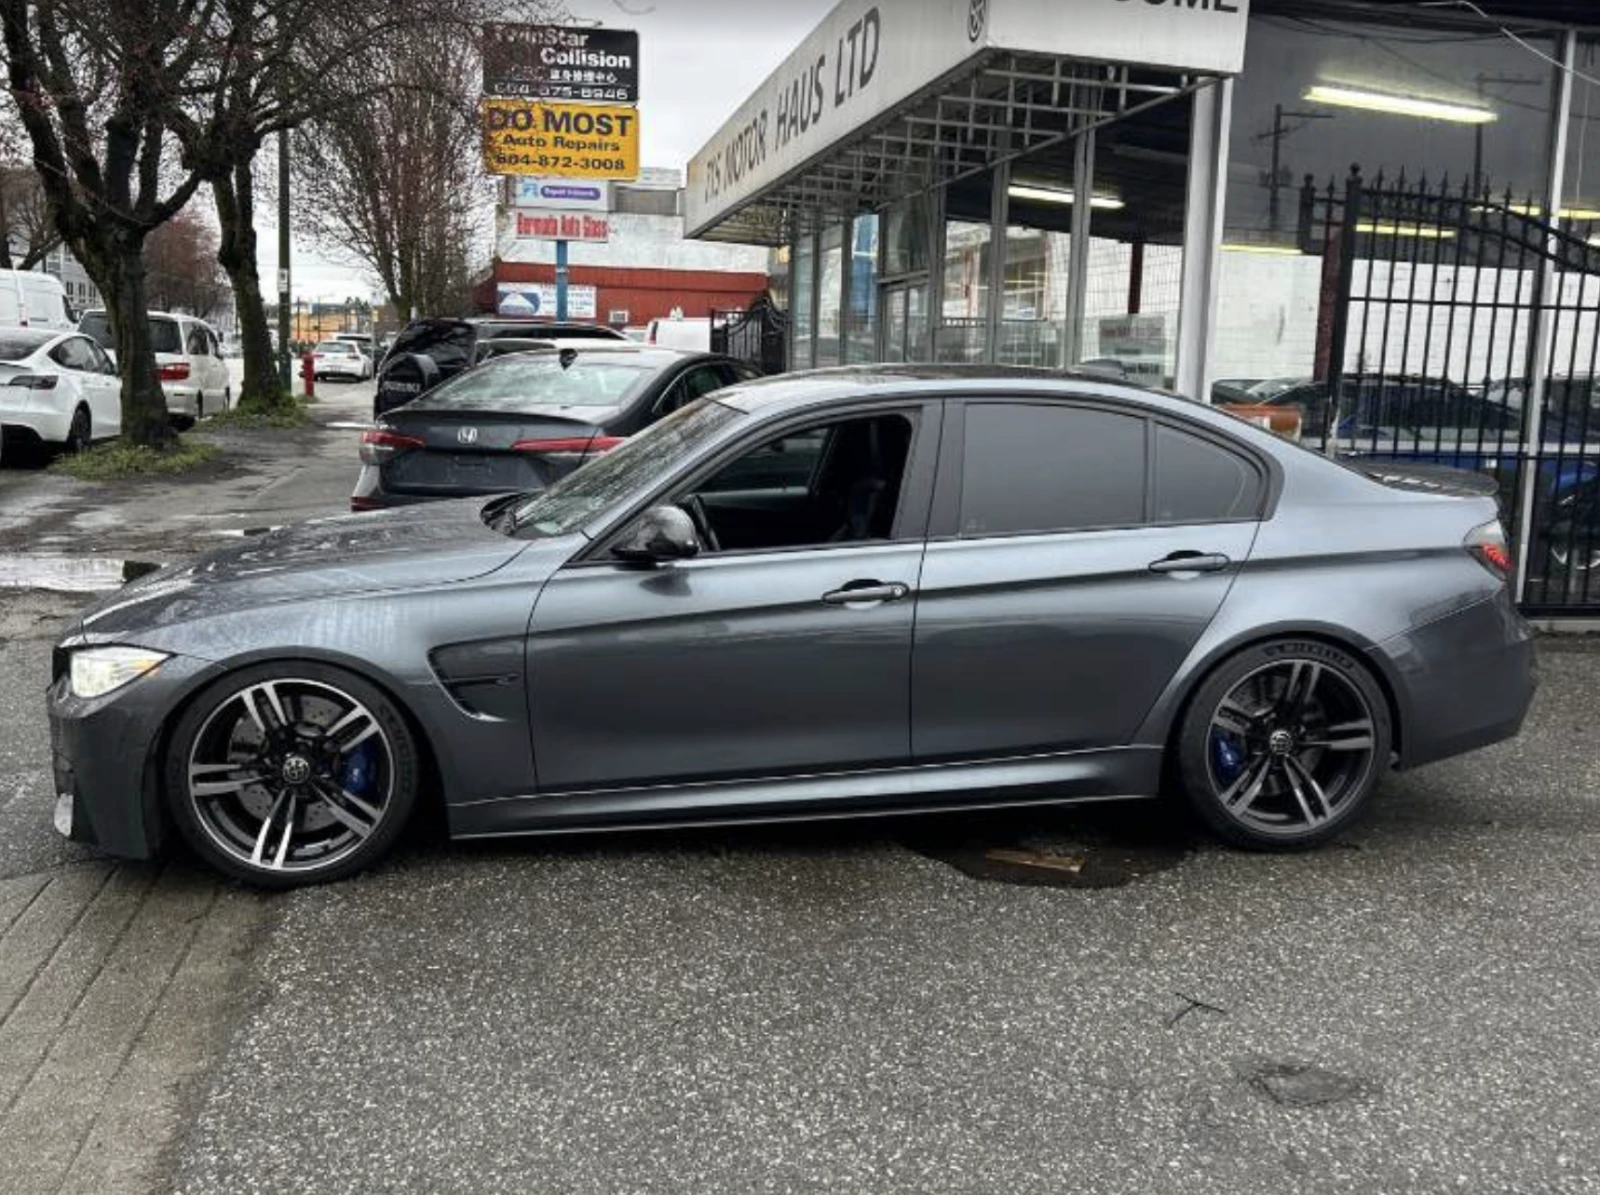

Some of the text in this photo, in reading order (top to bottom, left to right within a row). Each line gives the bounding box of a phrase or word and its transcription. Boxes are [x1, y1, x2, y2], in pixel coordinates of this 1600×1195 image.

[540, 47, 632, 69] Collision
[724, 108, 767, 191] MOTOR
[775, 53, 826, 151] HAUS
[834, 6, 881, 108] LTD
[489, 106, 633, 137] DO MOST
[503, 133, 620, 152] Auto Repairs
[494, 153, 626, 171] 604-872-3008
